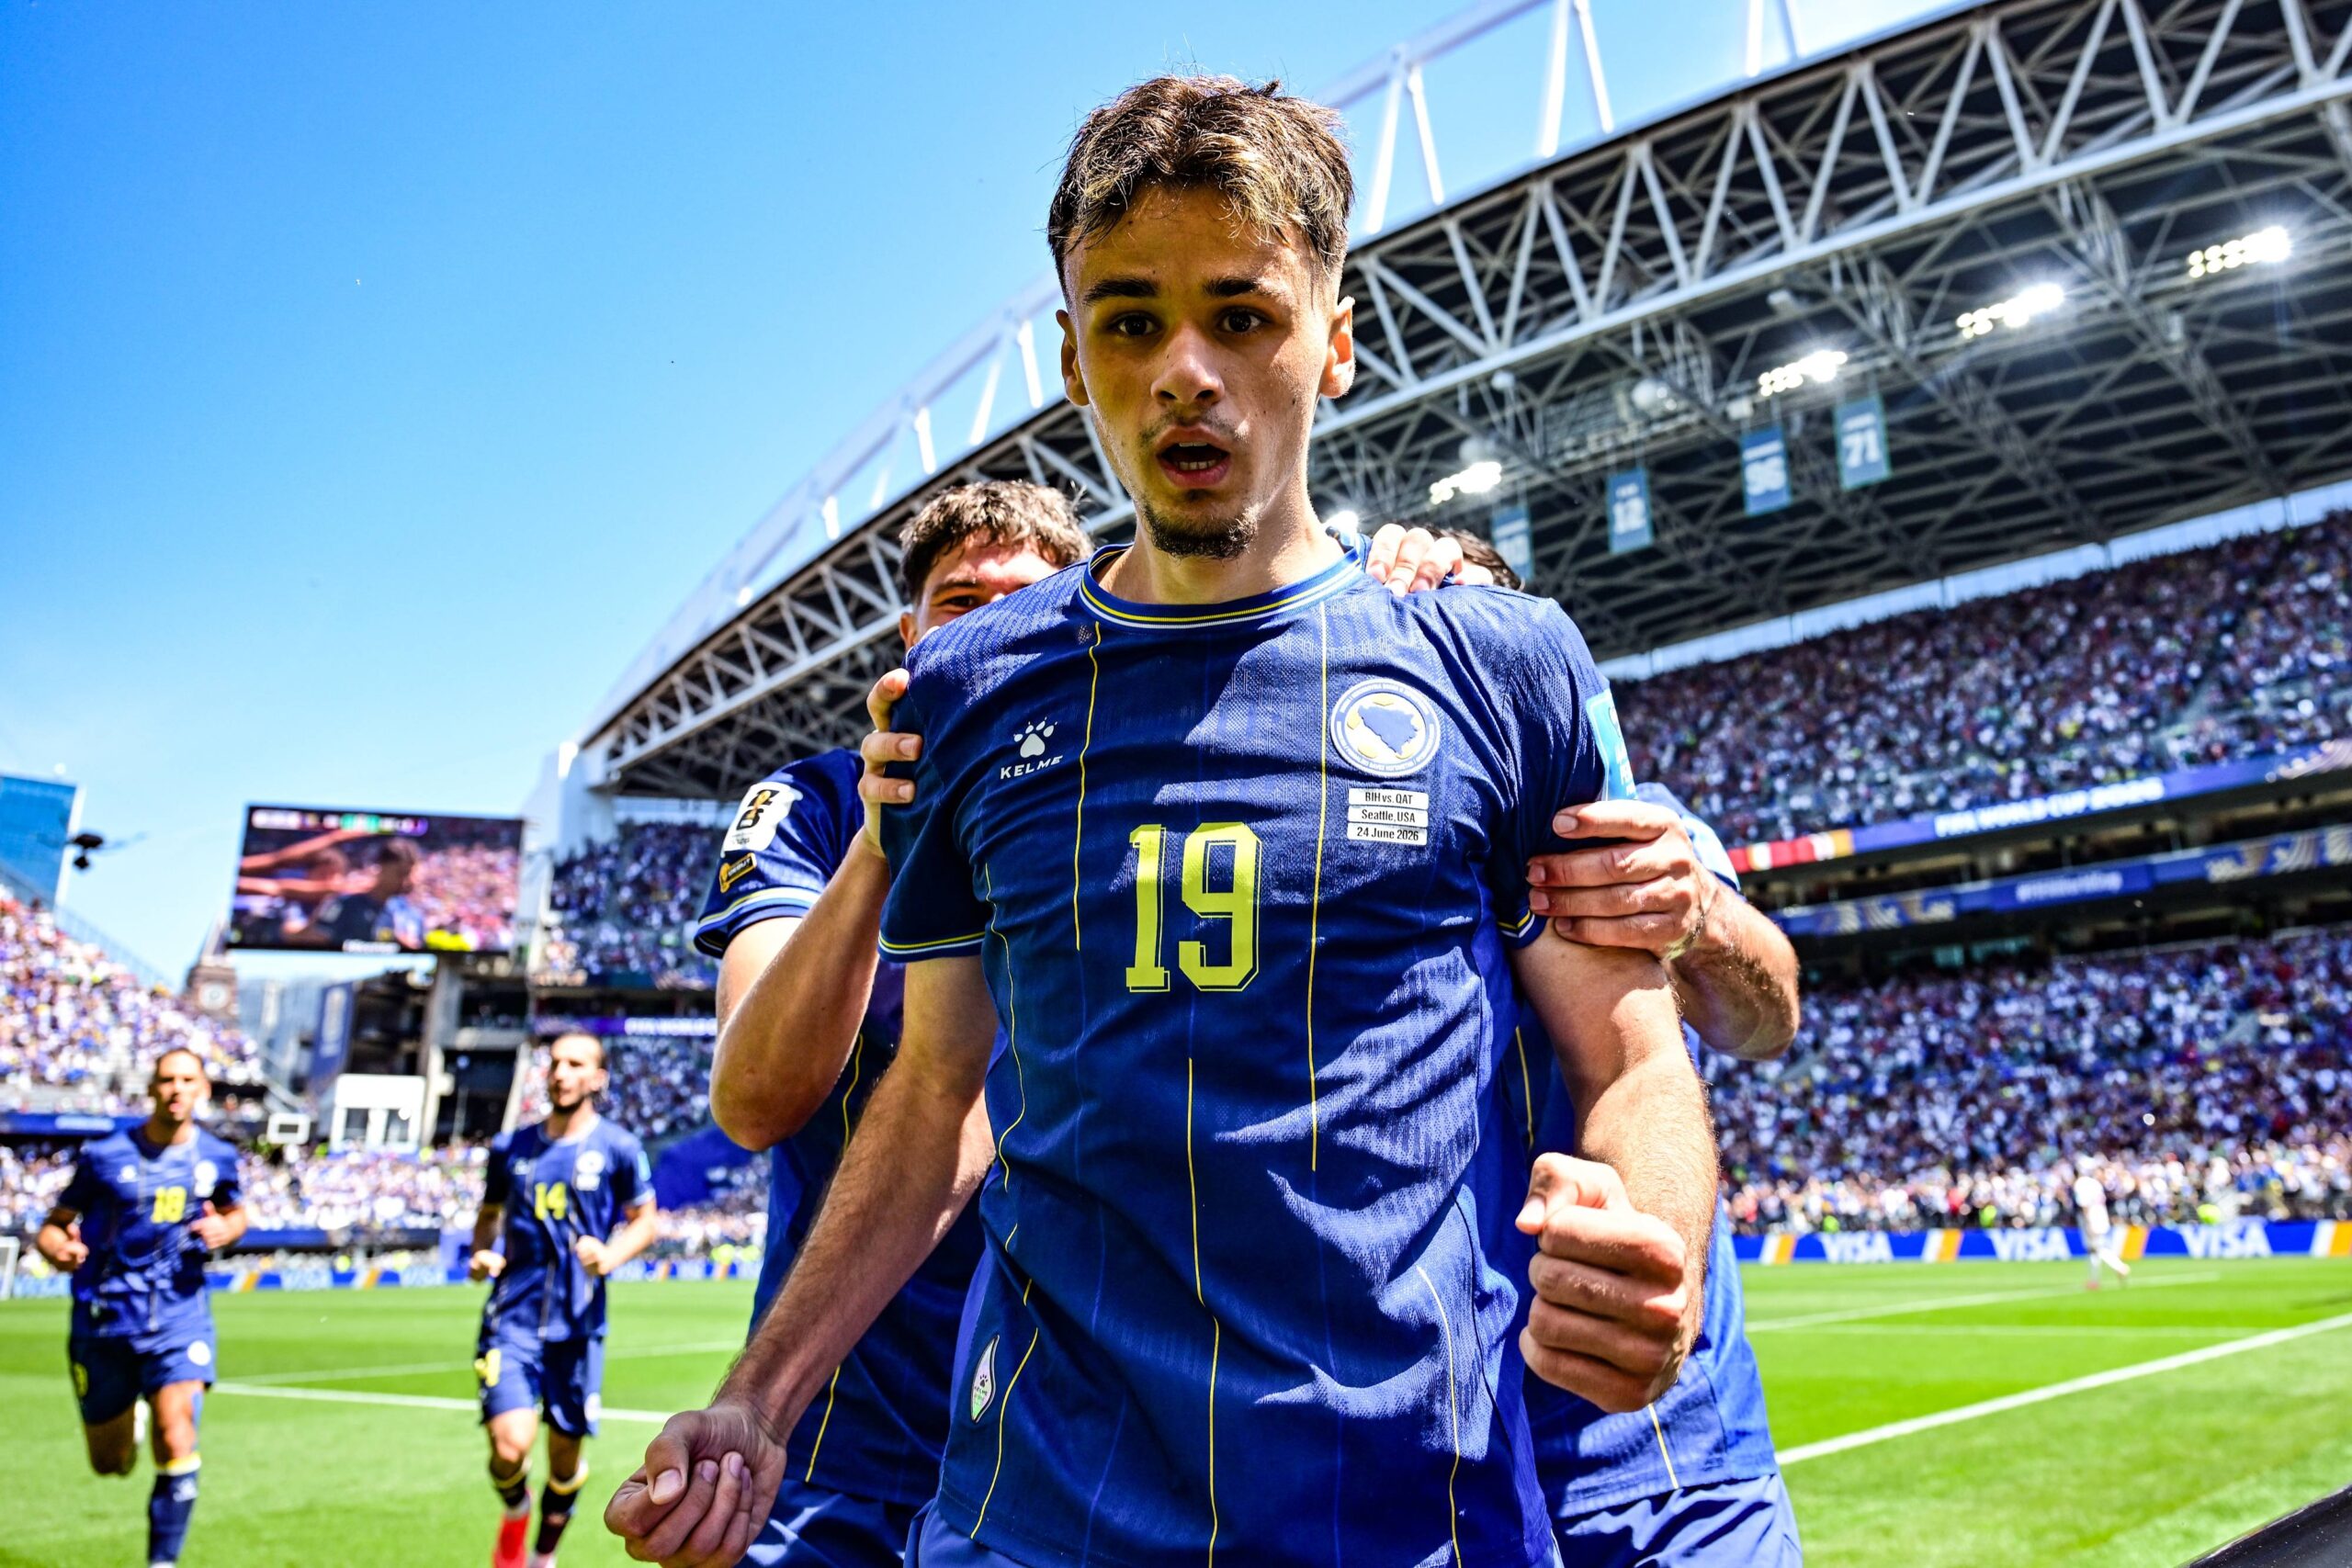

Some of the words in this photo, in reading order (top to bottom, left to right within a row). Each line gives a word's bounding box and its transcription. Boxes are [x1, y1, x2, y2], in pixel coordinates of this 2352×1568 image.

[1842, 428, 1882, 468] 71
[1000, 755, 1063, 780] KELME
[1365, 792, 1380, 802] BIH
[1396, 794, 1413, 805] QAT
[1357, 827, 1369, 837] 24
[1372, 828, 1395, 839] June
[1396, 829, 1419, 840] 2026
[1125, 821, 1262, 992] 19
[535, 1181, 567, 1220] 14
[1818, 1231, 1894, 1262] VISA
[1986, 1228, 2072, 1260] VISA
[2178, 1221, 2273, 1258] VISA
